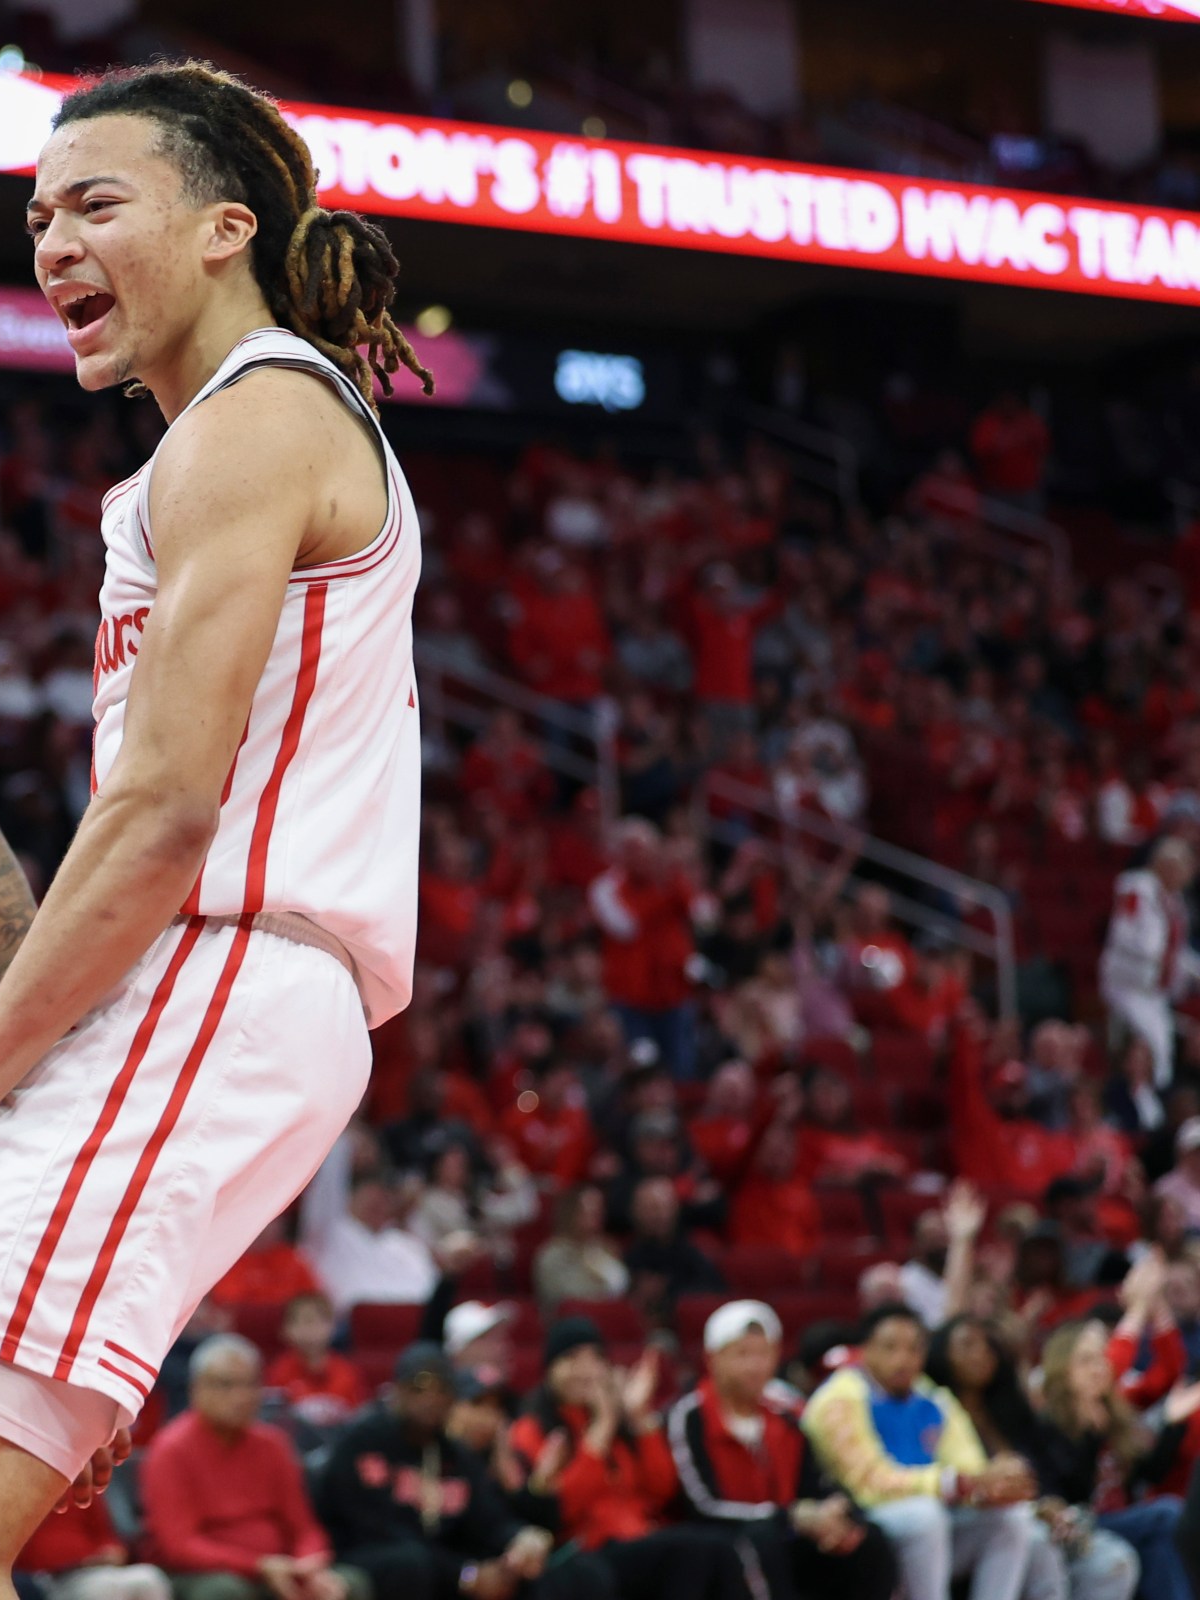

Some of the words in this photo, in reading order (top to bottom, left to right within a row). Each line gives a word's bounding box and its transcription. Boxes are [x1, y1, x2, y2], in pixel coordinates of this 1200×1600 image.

[281, 112, 541, 214] STON'S
[542, 141, 623, 225] #1
[625, 152, 900, 254] TRUSTED
[901, 186, 1070, 275] HVAC
